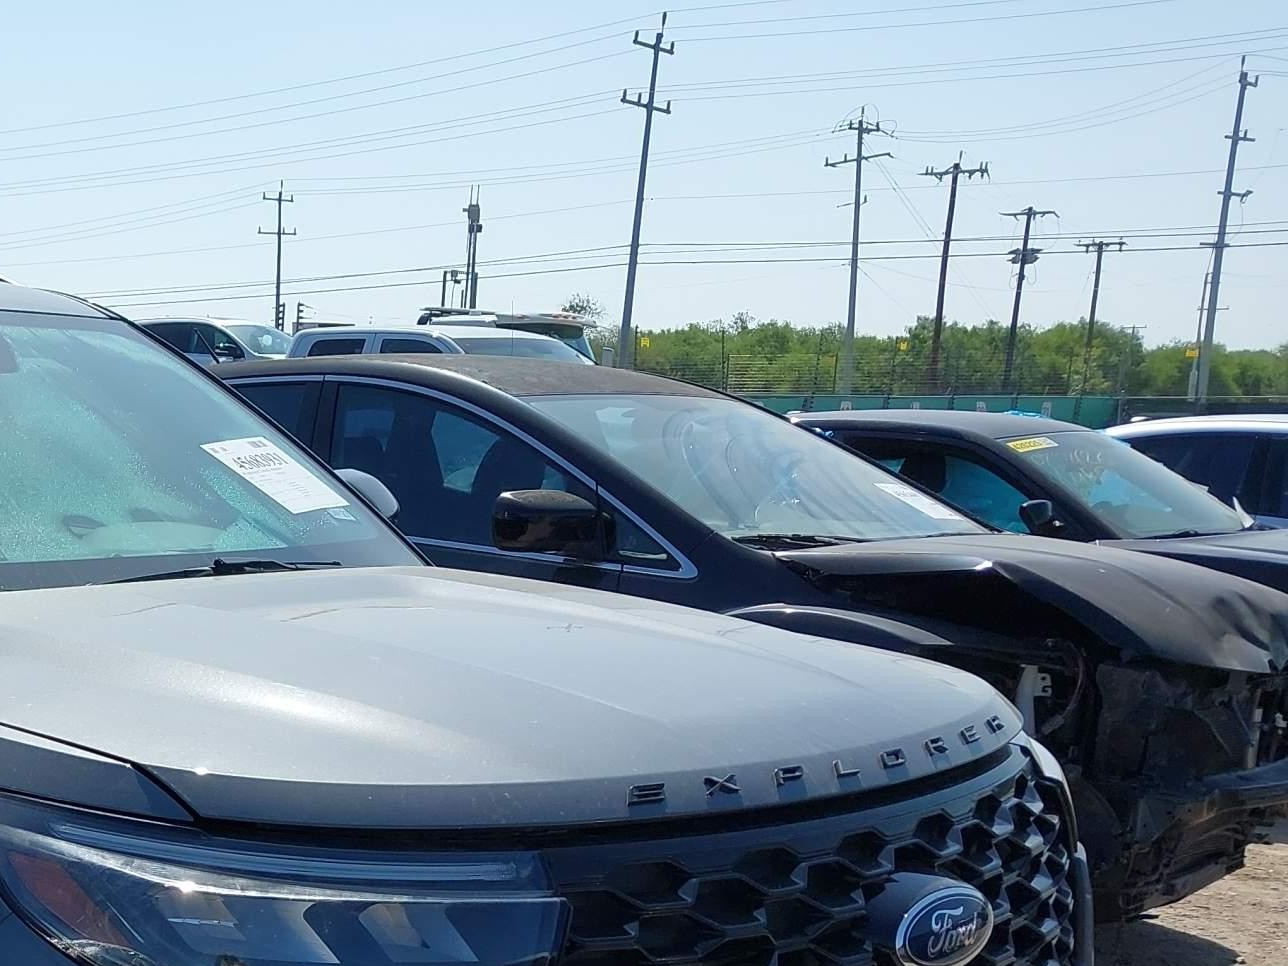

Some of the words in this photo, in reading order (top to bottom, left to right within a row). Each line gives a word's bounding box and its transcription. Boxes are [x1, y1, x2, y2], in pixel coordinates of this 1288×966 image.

[231, 452, 289, 471] 45683931
[627, 714, 1005, 806] EXPLORER
[927, 905, 978, 958] Ford
